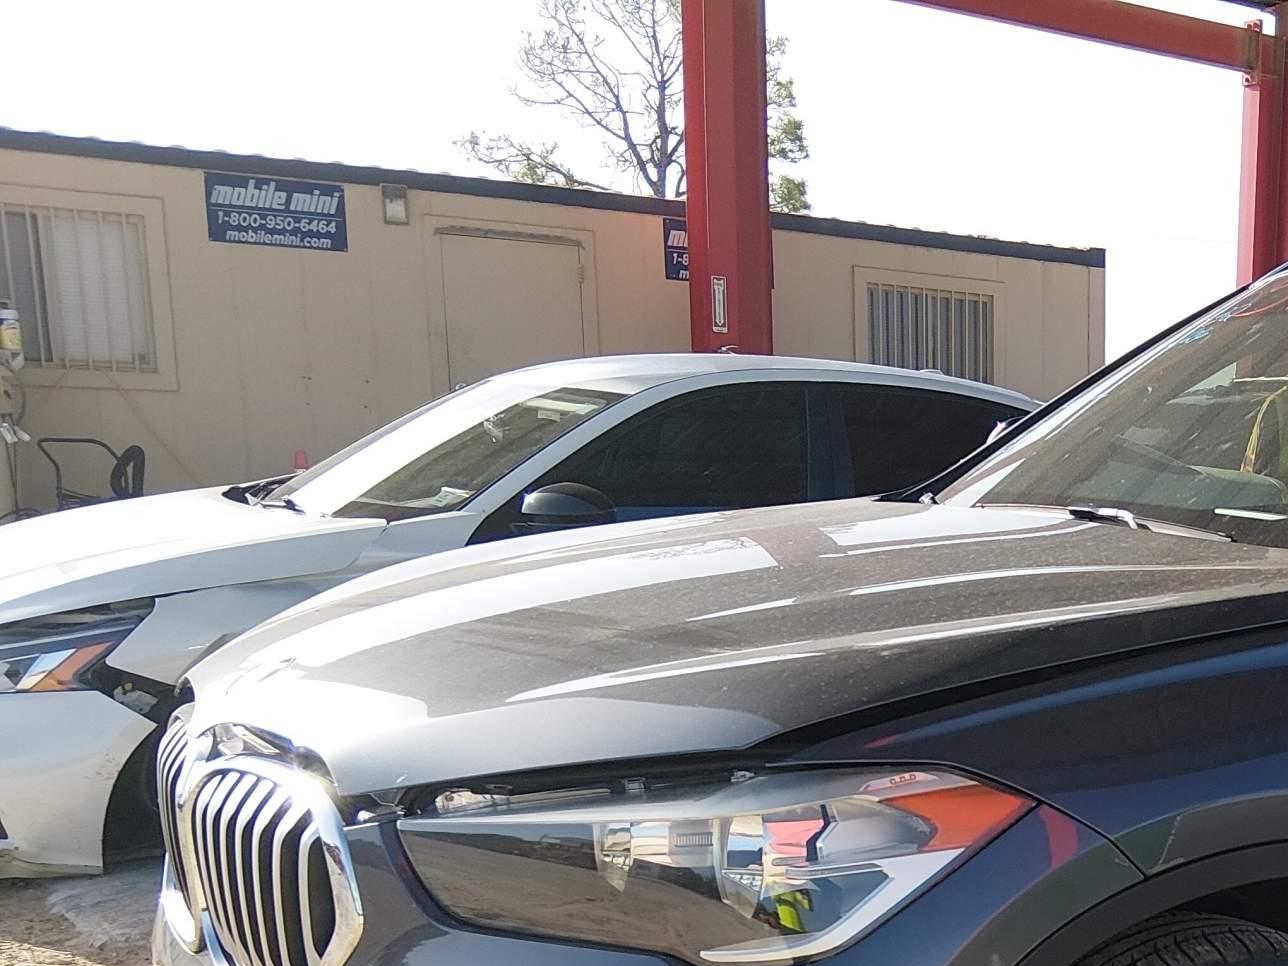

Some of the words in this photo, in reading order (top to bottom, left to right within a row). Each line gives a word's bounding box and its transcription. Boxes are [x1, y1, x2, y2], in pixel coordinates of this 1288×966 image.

[210, 179, 288, 210] mobile
[289, 189, 340, 215] mini
[217, 211, 337, 234] 1-800-950-6464
[226, 229, 332, 249] mobilemini.com
